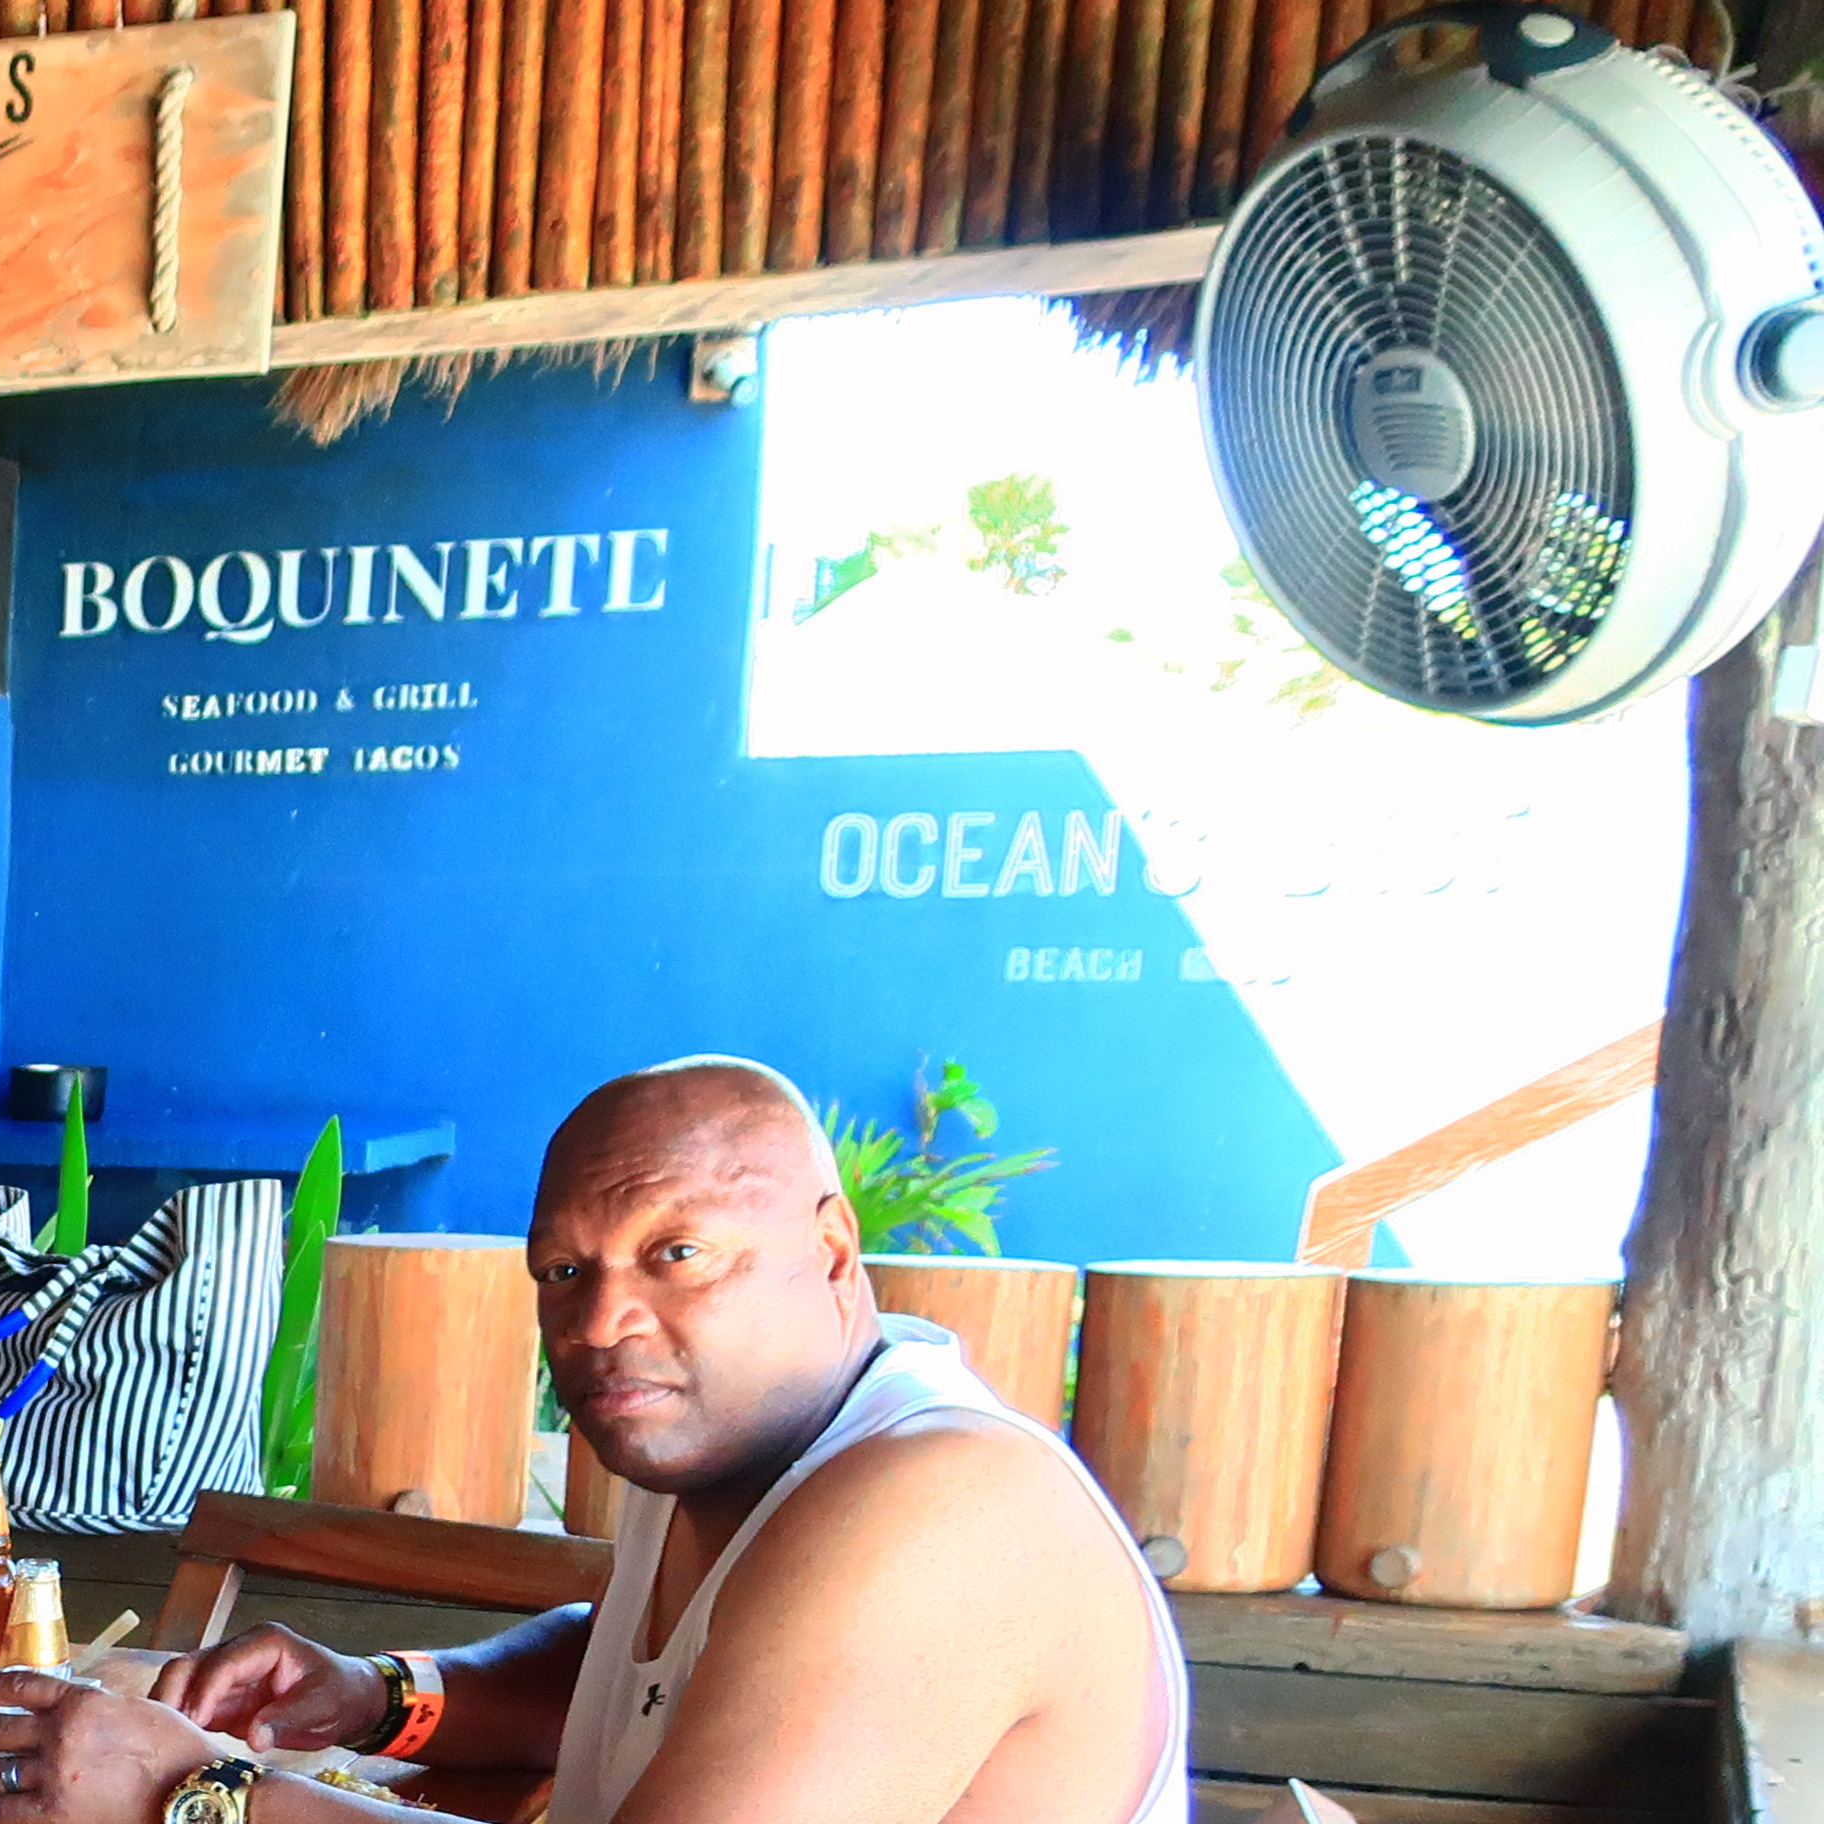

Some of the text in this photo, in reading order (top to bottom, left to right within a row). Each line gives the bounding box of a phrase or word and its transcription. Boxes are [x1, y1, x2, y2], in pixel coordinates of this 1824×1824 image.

[58, 528, 670, 643] BOQUINETE
[160, 682, 479, 721] SEAFOOD & GRILL
[167, 747, 330, 775] GOURMET
[1005, 946, 1144, 983] BEACH
